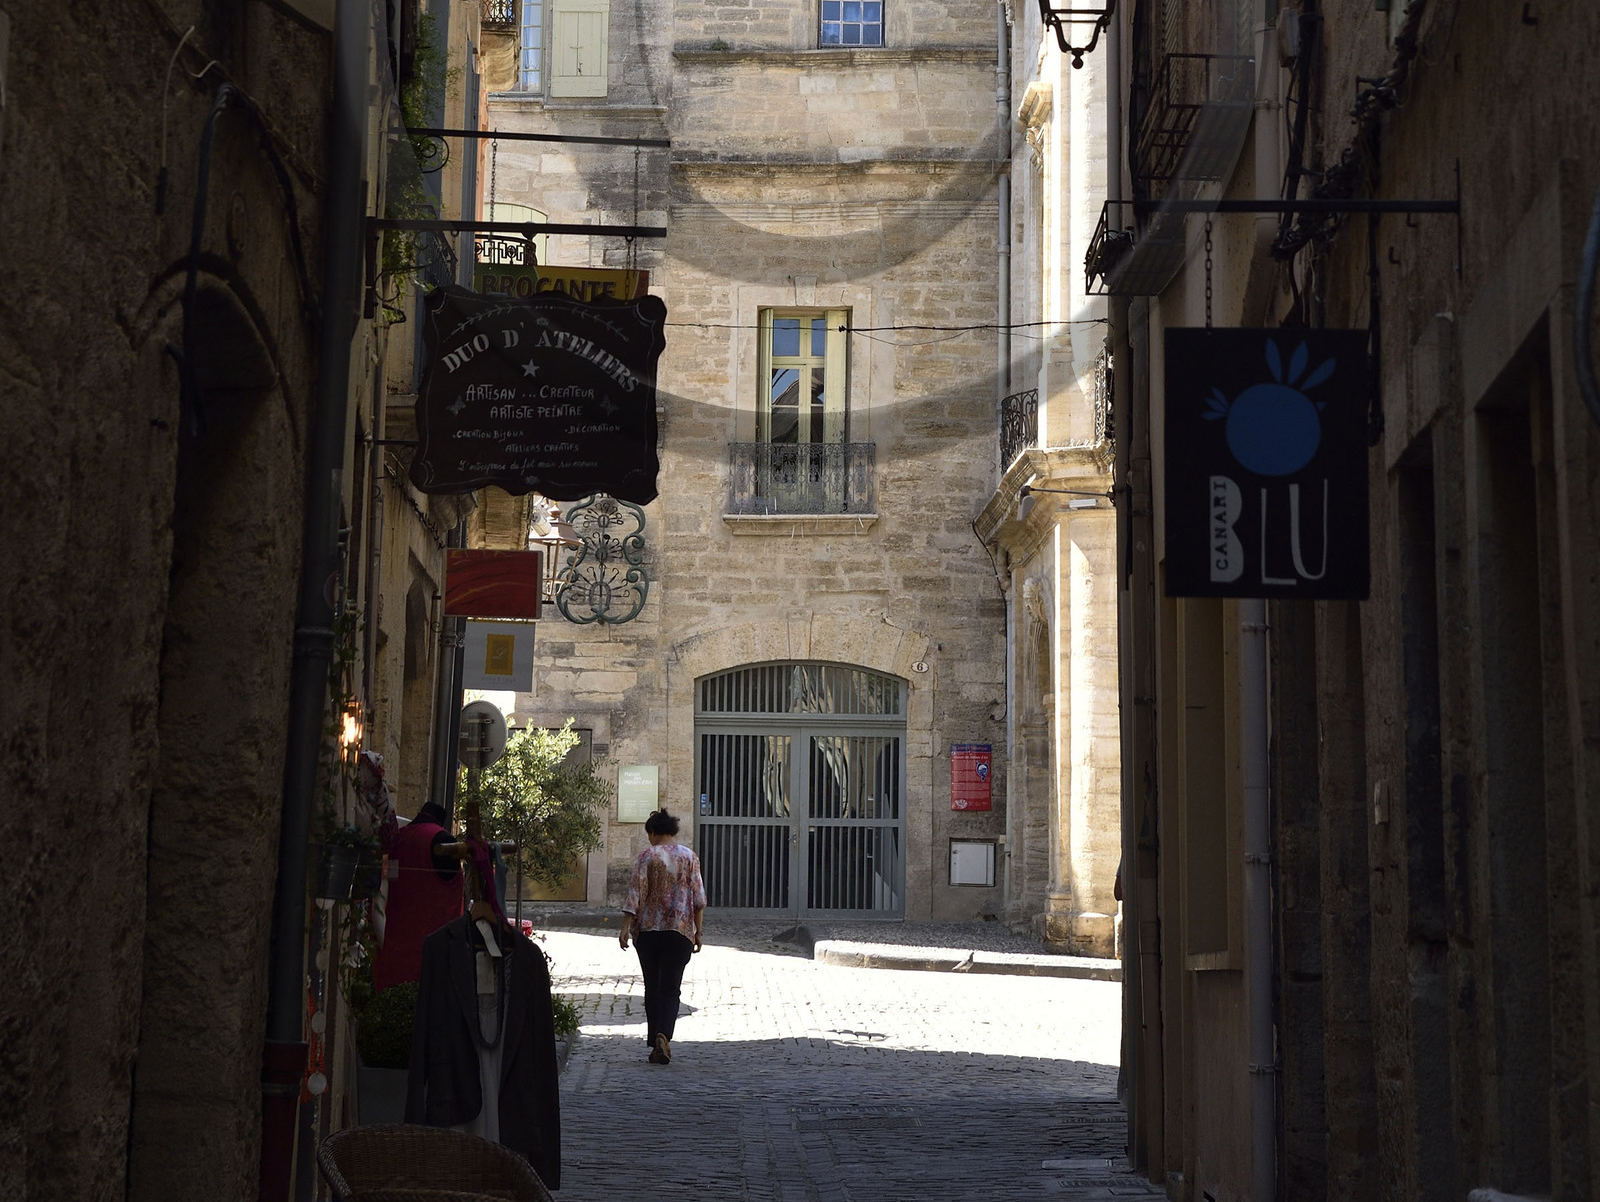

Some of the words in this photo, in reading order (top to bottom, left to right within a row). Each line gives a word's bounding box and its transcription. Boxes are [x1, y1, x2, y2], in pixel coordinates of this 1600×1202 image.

[482, 274, 616, 303] BROCANTE
[441, 332, 491, 374] DUO
[534, 329, 640, 393] ATELIERS
[1209, 474, 1329, 586] BLU
[1212, 480, 1229, 571] CANARI
[916, 662, 924, 672] 6
